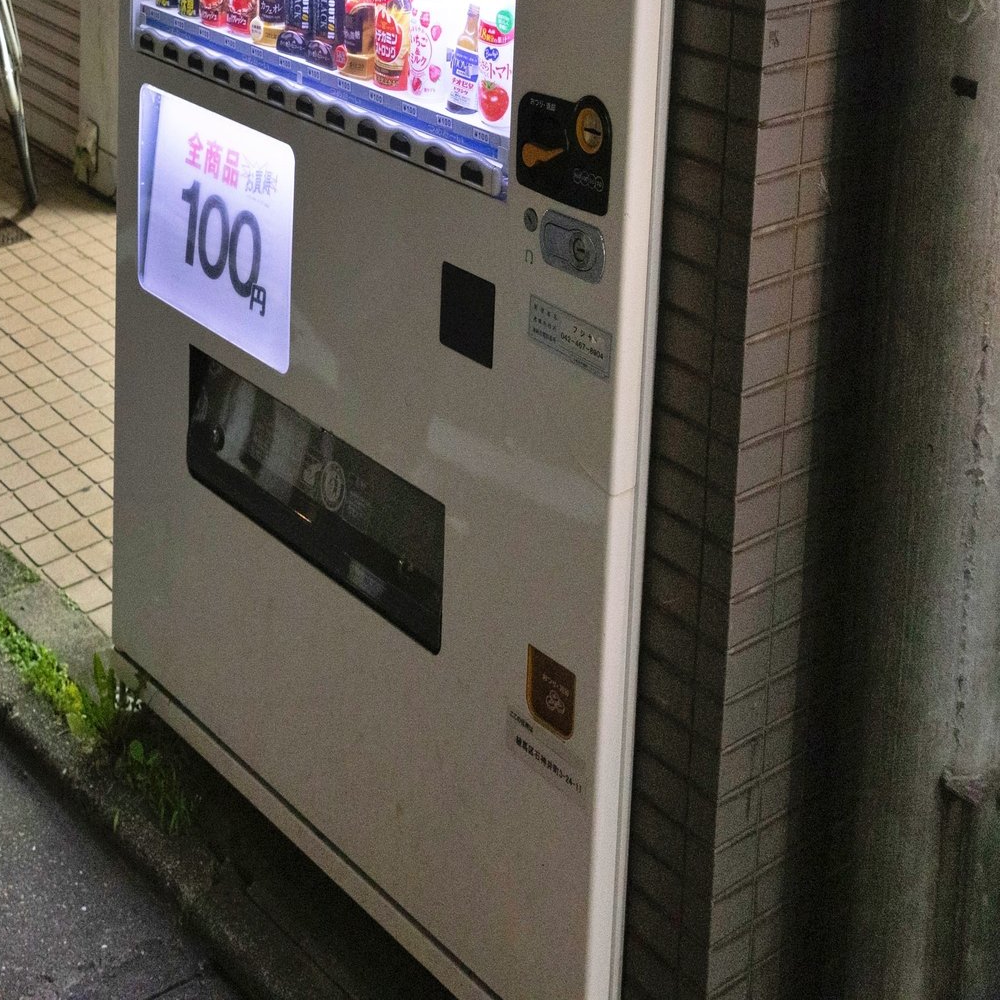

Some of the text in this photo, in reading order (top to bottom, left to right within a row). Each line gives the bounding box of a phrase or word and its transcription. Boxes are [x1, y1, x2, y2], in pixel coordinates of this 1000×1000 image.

[261, 1, 283, 14] カフェオレ
[489, 62, 512, 80] トマト
[452, 77, 474, 89] チオビタ
[185, 132, 240, 189] 全商品
[182, 179, 267, 317] 100 円
